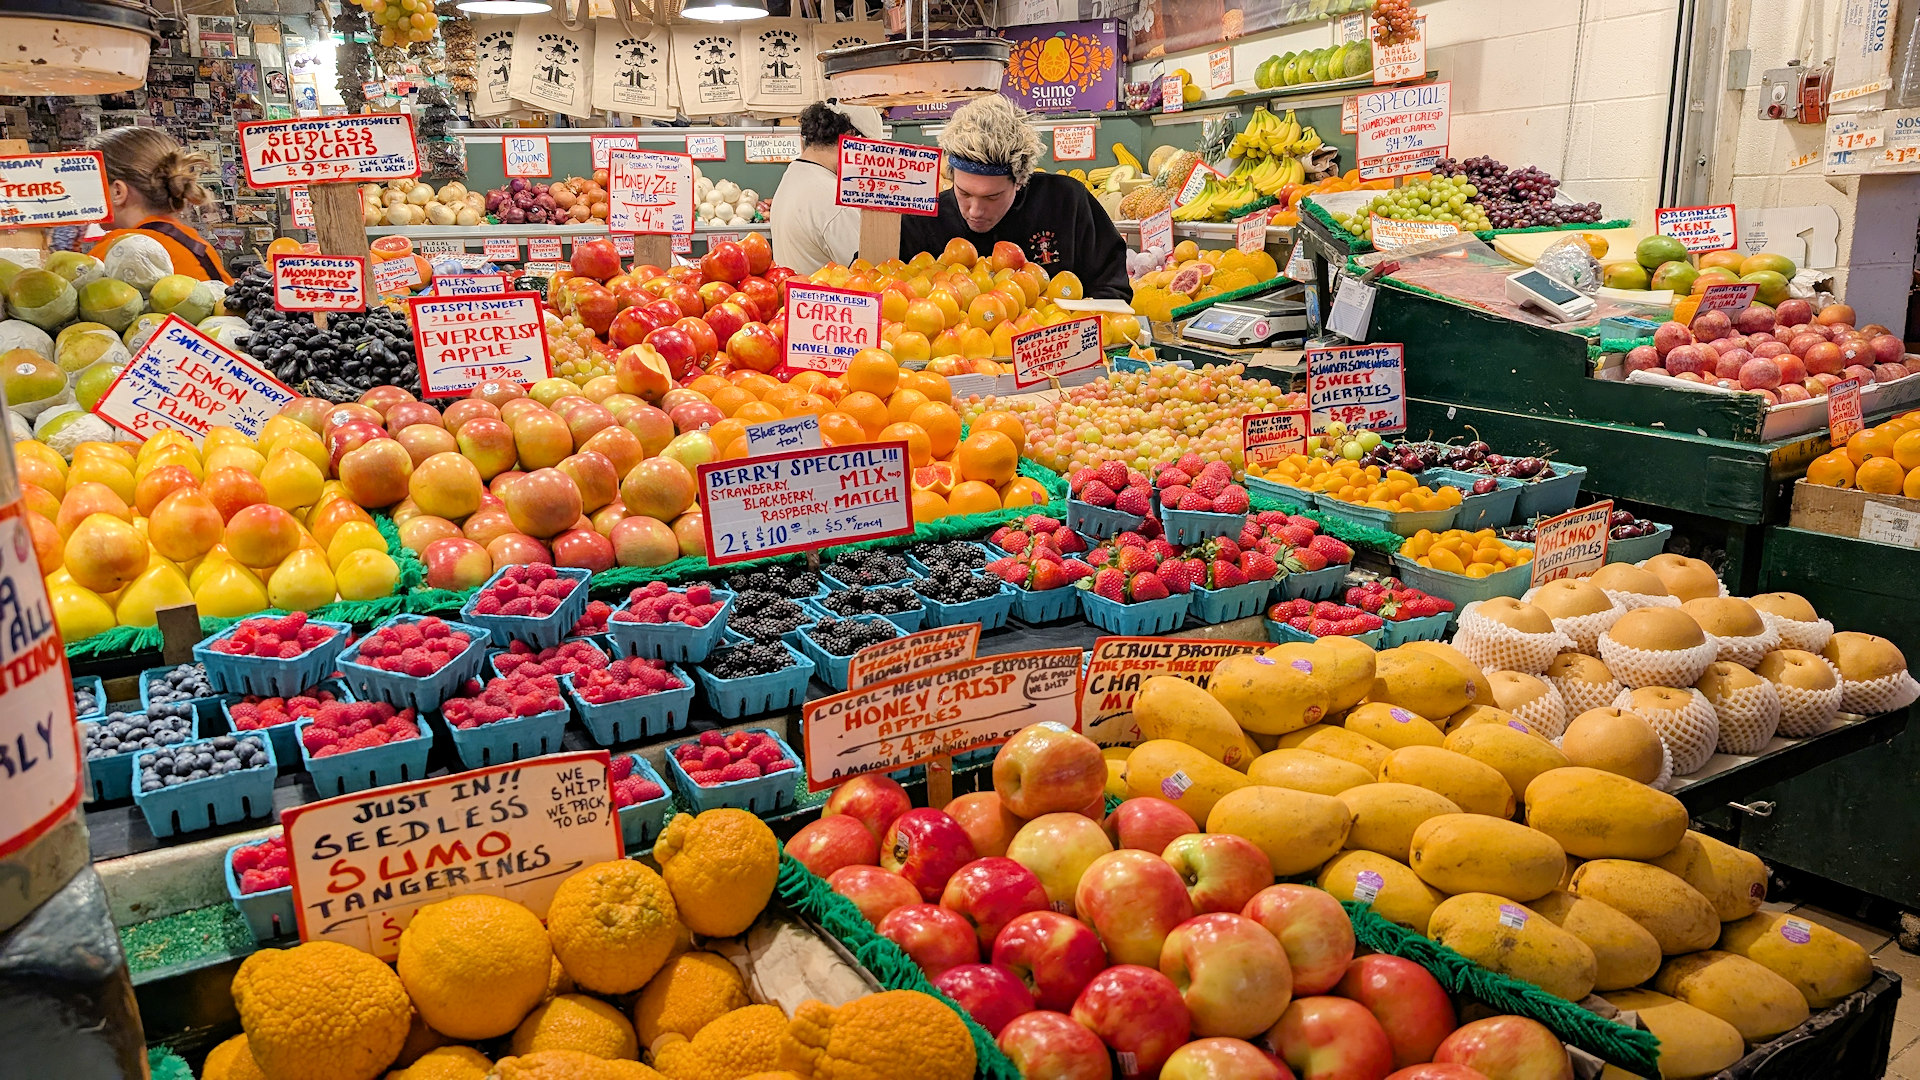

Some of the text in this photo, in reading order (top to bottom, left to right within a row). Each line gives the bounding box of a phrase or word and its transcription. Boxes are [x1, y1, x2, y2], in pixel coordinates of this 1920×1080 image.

[1380, 52, 1417, 66] ORANGES
[1384, 46, 1412, 57] NAVEL
[1212, 62, 1228, 76] QUINCE
[1832, 83, 1880, 100] PEACHES
[916, 102, 948, 111] CITRUS
[1036, 98, 1072, 108] CITRUS
[1364, 87, 1442, 114] SPECIAL
[1360, 111, 1444, 133] JUMBO CRISP
[246, 125, 288, 136] EXPORT
[268, 127, 374, 148] SEEDLESS
[1055, 130, 1092, 138] ORGANIC
[511, 138, 535, 152] RED
[597, 138, 634, 148] YELLOW
[690, 144, 719, 154] ONIONS
[261, 140, 378, 166] MUSCATS
[508, 152, 545, 166] ONIONS
[752, 148, 796, 156] SHALLOTS
[918, 151, 939, 160] CROP
[1362, 158, 1384, 167] RUBY
[1386, 150, 1440, 164] CONSTELLATION
[358, 156, 406, 168] LIKE WINE
[359, 166, 372, 174] IN
[375, 164, 382, 172] A
[844, 152, 936, 173] LEMON DROP
[614, 163, 678, 194] HONEY-ZEE
[858, 167, 906, 180] PLUMS
[4, 181, 66, 198] PEARS
[1180, 168, 1203, 204] BONELESS
[631, 189, 658, 203] APPLES
[57, 210, 78, 218] SOME
[908, 202, 934, 210] TRAVEL
[1396, 222, 1440, 230] EXCLUSIVE
[1660, 218, 1682, 226] SWEET
[1673, 221, 1712, 232] KENT
[1376, 228, 1438, 240] STRAWBERRIES
[1667, 228, 1716, 237] MANGOS
[282, 268, 356, 278] MOONDROP
[290, 278, 350, 288] GRAPES
[438, 278, 476, 288] ALEX'S
[452, 284, 504, 296] FAVORITE
[820, 294, 842, 303] PINK
[844, 296, 867, 306] FLESH
[1734, 292, 1748, 300] EGG
[422, 299, 524, 314] CRISPY SWEET
[1708, 300, 1736, 309] PLUMS
[443, 310, 504, 322] LOCAL
[796, 302, 854, 324] CARA
[422, 322, 540, 348] EVERCRISP
[812, 324, 868, 344] CARA
[1081, 330, 1098, 339] WINE
[1084, 323, 1098, 334] LIKE
[792, 344, 828, 354] NAVEL
[1016, 332, 1070, 354] SEEDLESS
[1022, 340, 1070, 362] MUSCAT
[146, 354, 162, 366] WE
[438, 342, 514, 363] APPLE
[1028, 352, 1062, 368] GRAPES
[1311, 348, 1389, 362] IT'S ALWAYS
[131, 368, 146, 381] FOR
[140, 363, 162, 379] PACK
[1310, 356, 1400, 378] SUMMER SOMEWHERE
[174, 356, 248, 405] LEMON
[228, 365, 258, 388] NEW
[1314, 370, 1375, 391] SWEET
[430, 382, 477, 392] HONEYCRISP
[1311, 384, 1392, 405] CHERRIES
[176, 382, 226, 416] DROP
[242, 414, 258, 428] WE
[1248, 422, 1293, 436] SWEET TART
[1250, 416, 1292, 428] NEW CROP
[1313, 416, 1398, 435] WE TO GO!
[1249, 428, 1298, 446] KUMQUATS
[709, 462, 780, 488] BERRY
[839, 466, 901, 491] MIX AND
[834, 486, 898, 509] MATCH
[720, 528, 820, 554] 2 OR
[1538, 540, 1602, 574] PEAR APPLES
[10, 600, 54, 653] ALL
[858, 628, 972, 664] THESE ARE NOT
[1102, 643, 1266, 662] CIRULI BROTHERS
[857, 635, 968, 676] PIGGLY WIGGLY
[862, 646, 966, 686] HONEY CRISP
[1092, 660, 1118, 674] THE
[1029, 668, 1076, 684] WE PACK
[1028, 678, 1069, 695] WE SHIP
[844, 674, 1018, 732] HONEY CRISP
[878, 704, 962, 737] APPLES
[556, 766, 584, 784] WE
[352, 768, 522, 824] JUST IN!!
[546, 794, 606, 820] WE PACK
[312, 795, 530, 860] SEEDLESS
[554, 815, 574, 829] TO
[327, 830, 512, 894] SUMO
[308, 844, 551, 919] TANGERINES
